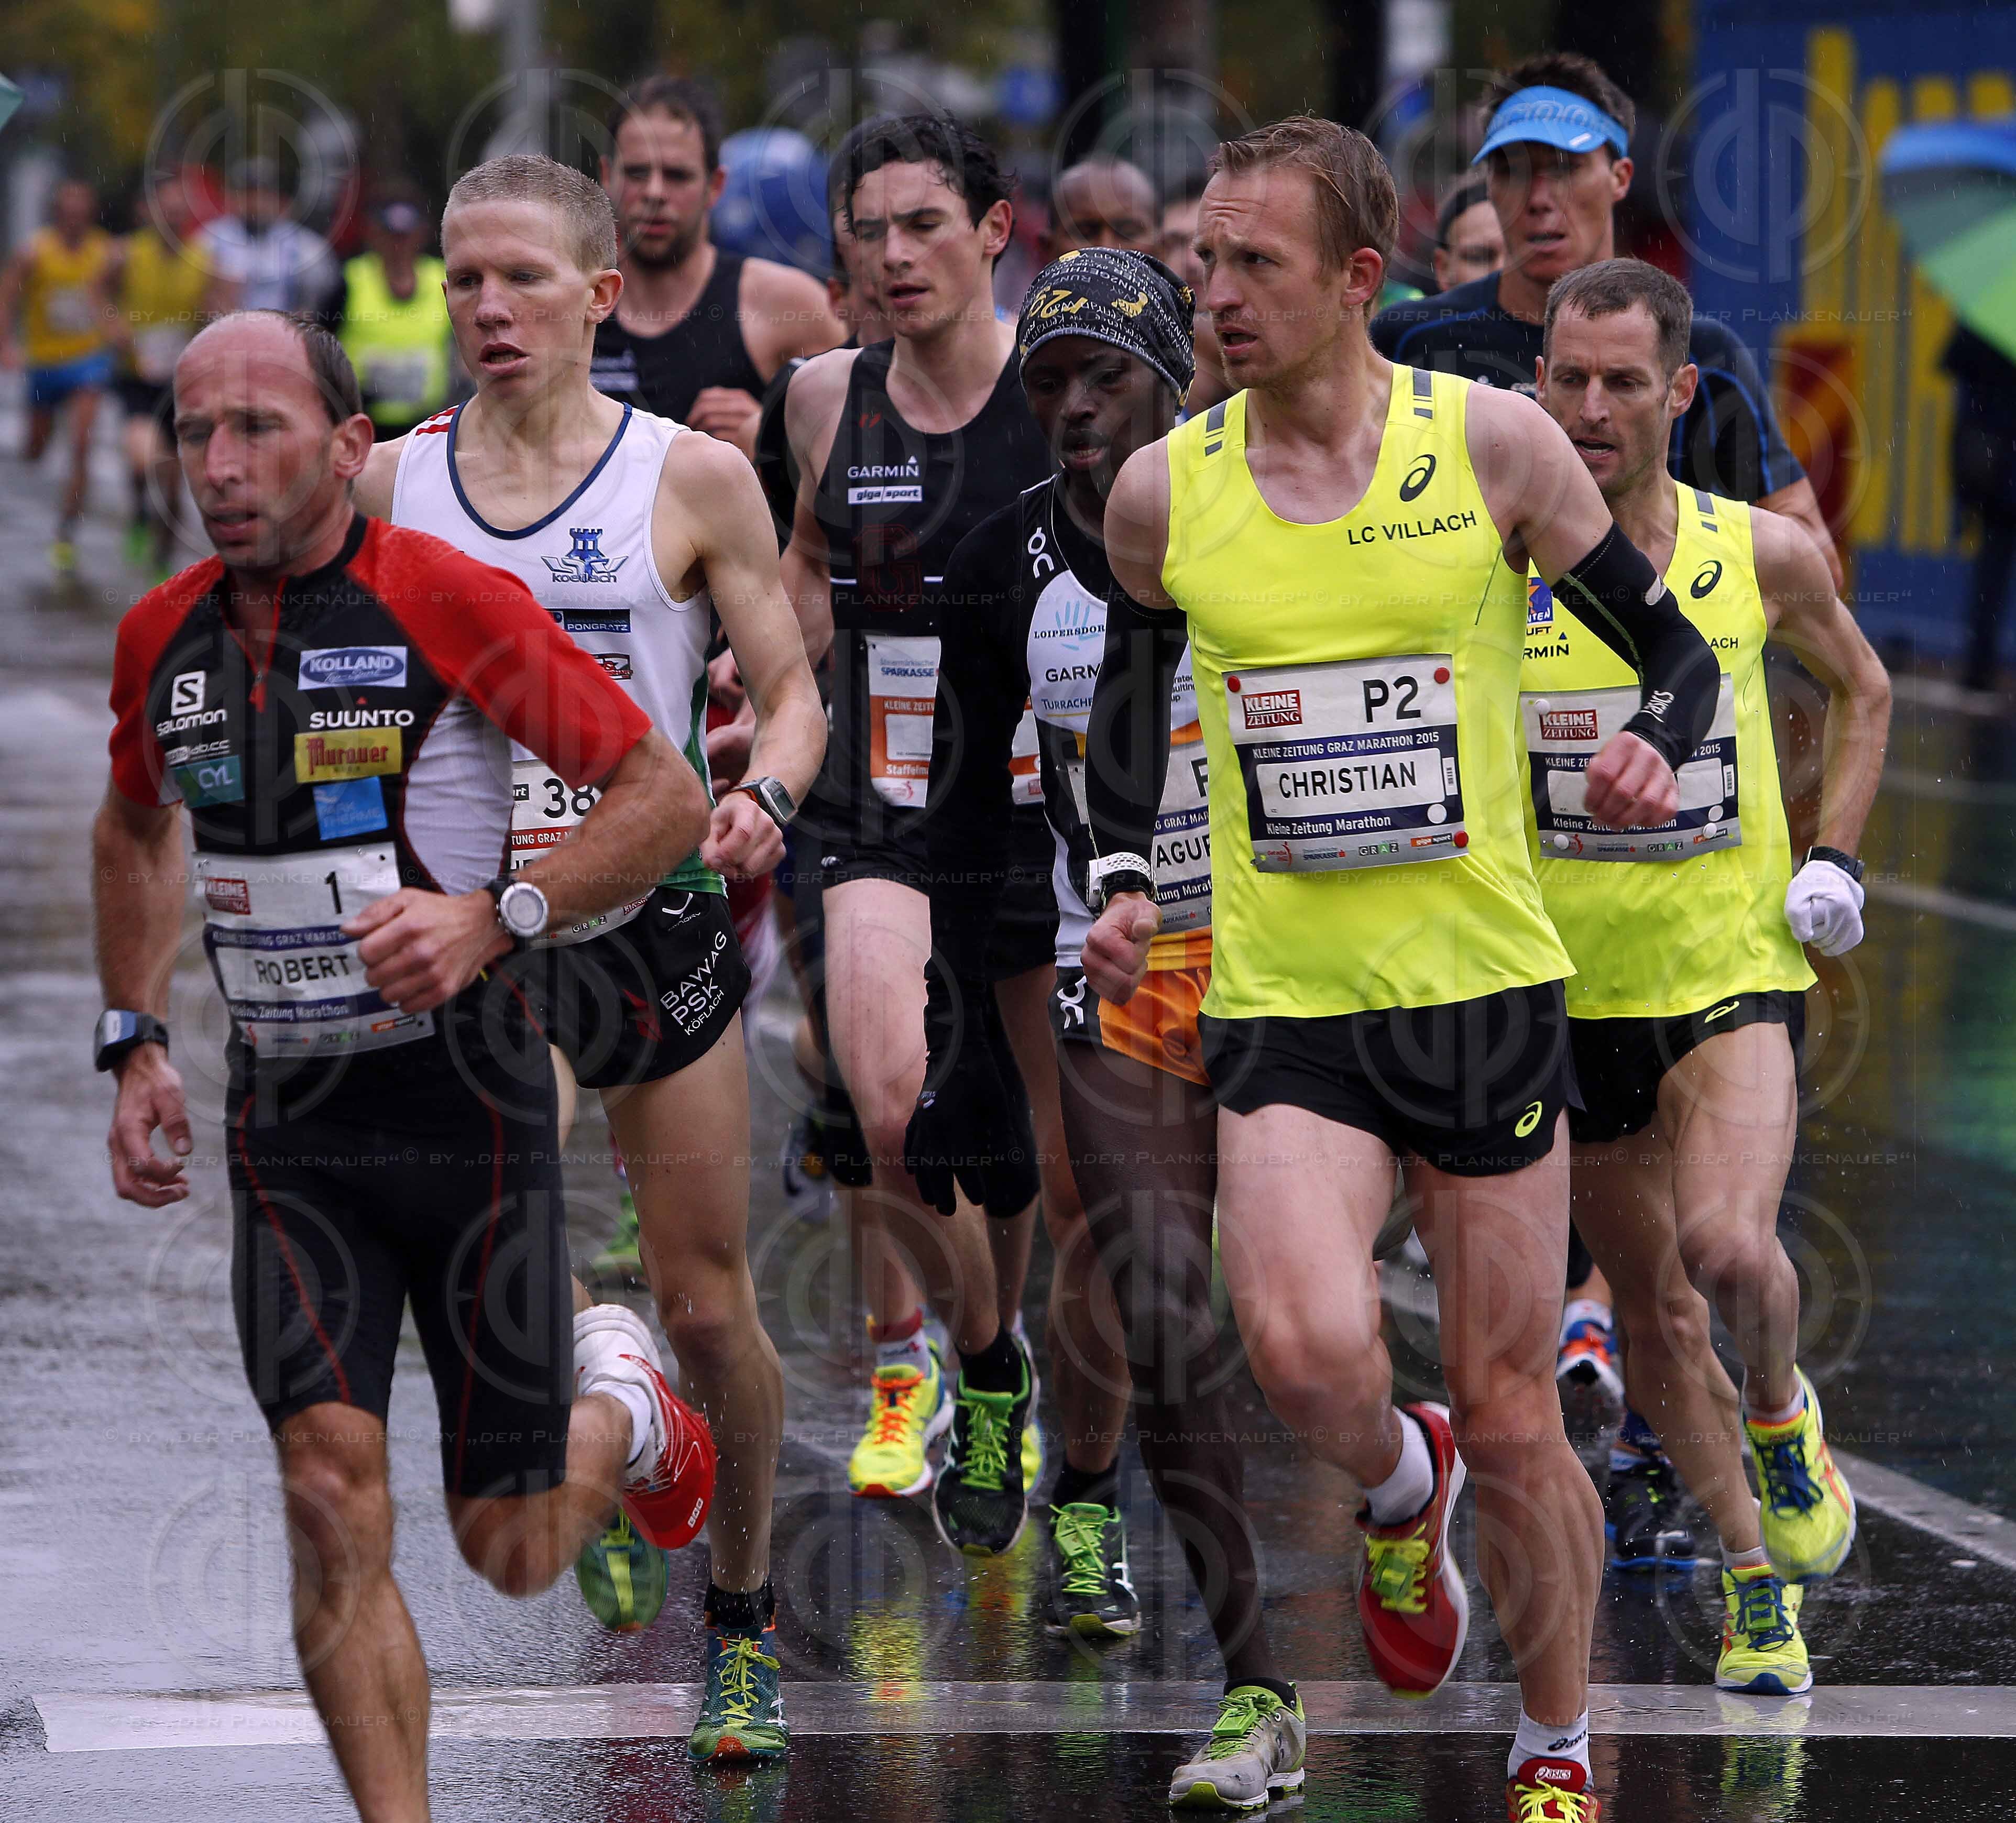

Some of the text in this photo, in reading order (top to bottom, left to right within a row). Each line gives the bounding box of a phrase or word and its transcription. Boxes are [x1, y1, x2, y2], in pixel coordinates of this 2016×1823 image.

[847, 465, 919, 478] GARMIN
[1347, 510, 1477, 545] LC VILLACH
[567, 623, 628, 631] PONGRATZ
[1710, 637, 1738, 649] ACH
[310, 655, 394, 672] KOLLAND
[881, 666, 935, 677] SPARKASSE
[1244, 693, 1298, 711] KLEINE
[1363, 675, 1421, 723] P2
[310, 709, 414, 729] SUUNTO
[1247, 711, 1300, 726] ZEITUNG
[1542, 712, 1594, 726] KLEINE
[1543, 727, 1596, 738] ZEITUNG
[1252, 731, 1440, 759] KLEINE ZEITUNG GRAZ MARATHON 2015
[1700, 743, 1722, 755] 2015
[307, 738, 388, 775] Murauer
[1546, 757, 1575, 767] KLEINE
[1278, 761, 1417, 799] CHRISTIAN
[543, 778, 595, 818] 38
[1164, 815, 1188, 829] GRAZ
[1266, 815, 1392, 836] Kleine Zeitung Marathon
[1553, 817, 1583, 829] Kleine
[538, 832, 562, 843] GRAZ
[1360, 843, 1399, 856] GRAZ
[326, 871, 342, 914] 1
[572, 916, 606, 934] GRAZ
[255, 954, 350, 985] ROBERT
[660, 931, 727, 1010] BAWAG
[671, 976, 718, 1025] PSK
[684, 990, 724, 1035] KÖFLACH
